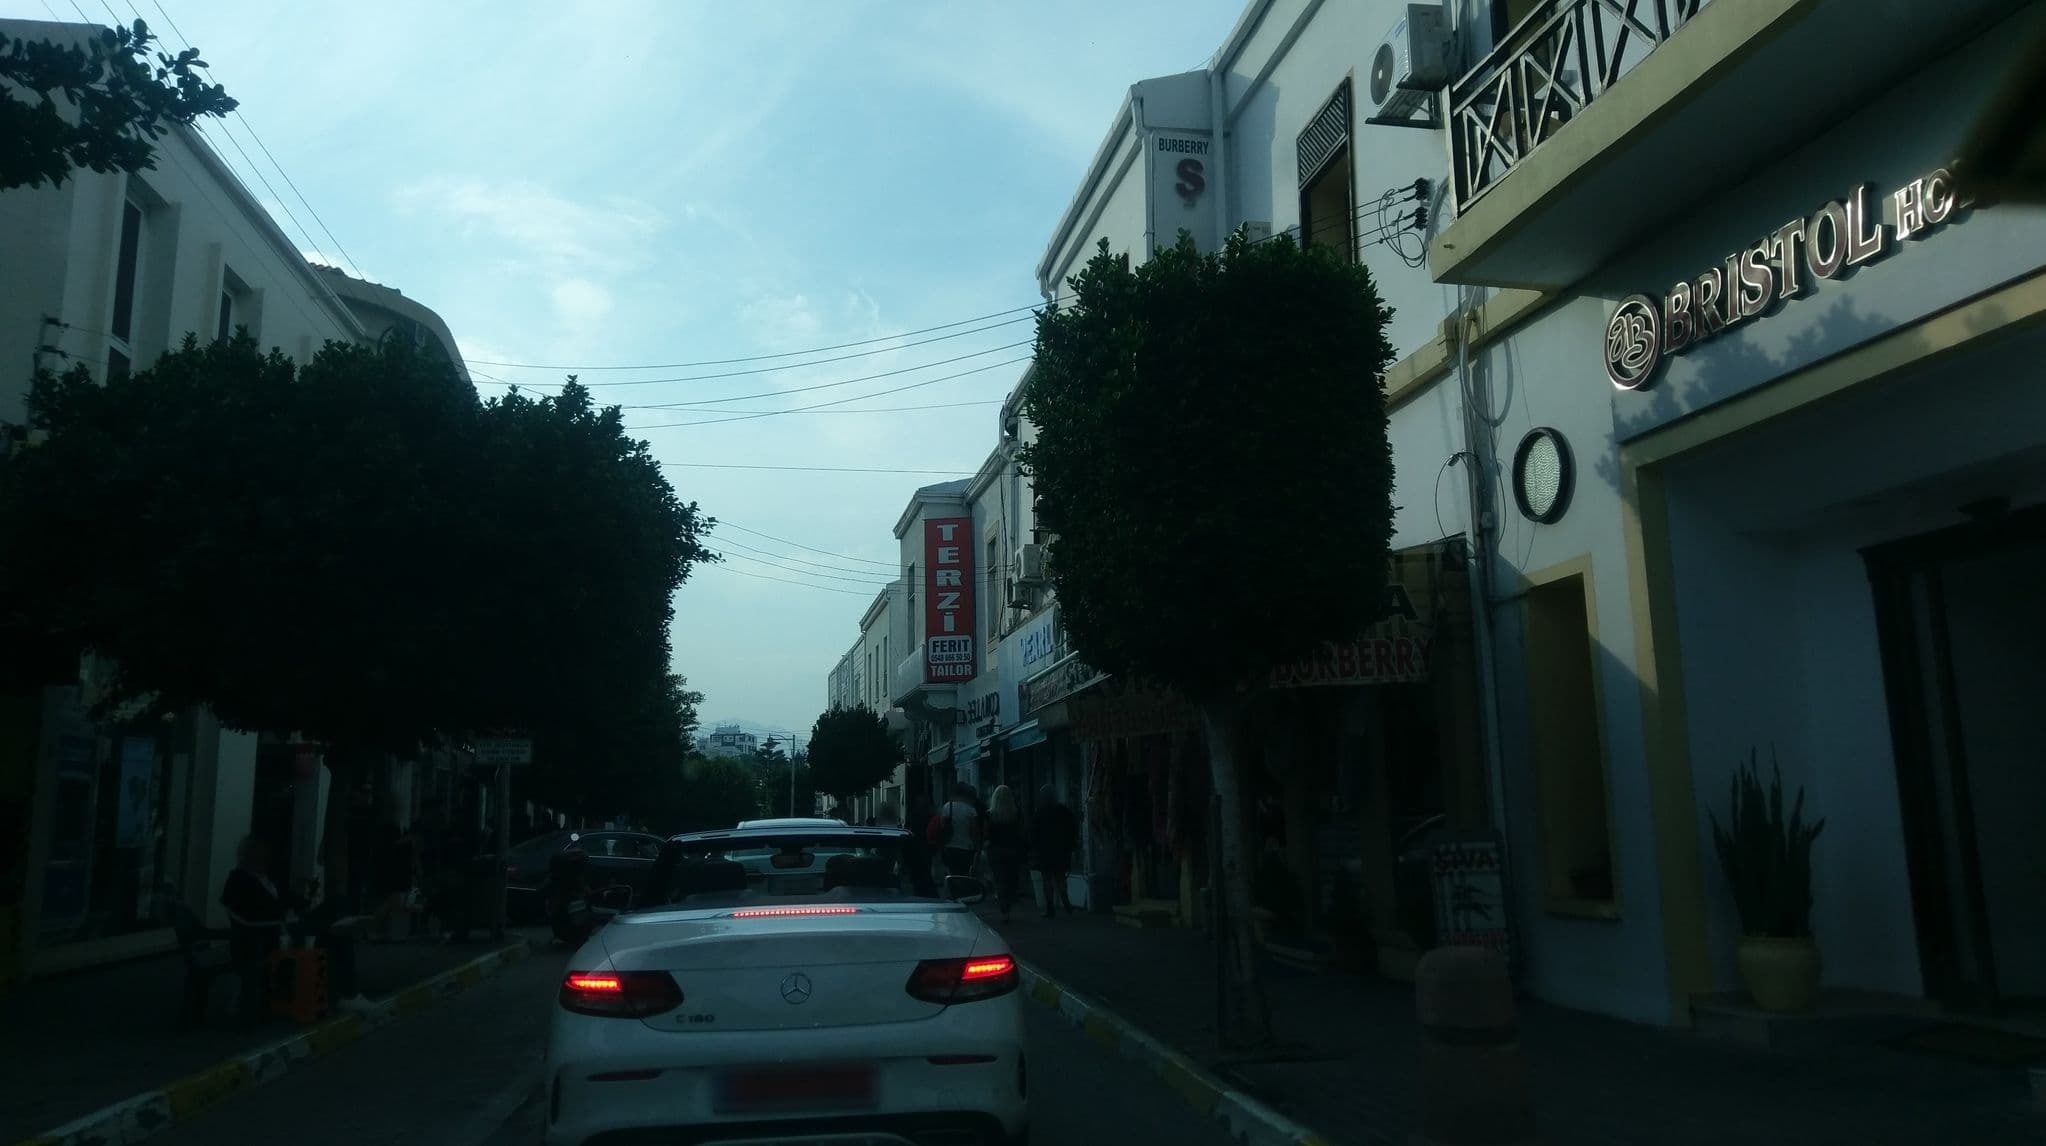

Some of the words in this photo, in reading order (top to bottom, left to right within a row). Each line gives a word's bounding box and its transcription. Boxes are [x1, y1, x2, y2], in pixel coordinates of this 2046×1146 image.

[1158, 137, 1209, 155] BURBERRY
[1663, 182, 1884, 355] BRISTOL
[932, 639, 970, 653] FERIT
[930, 664, 972, 677] TAILOR
